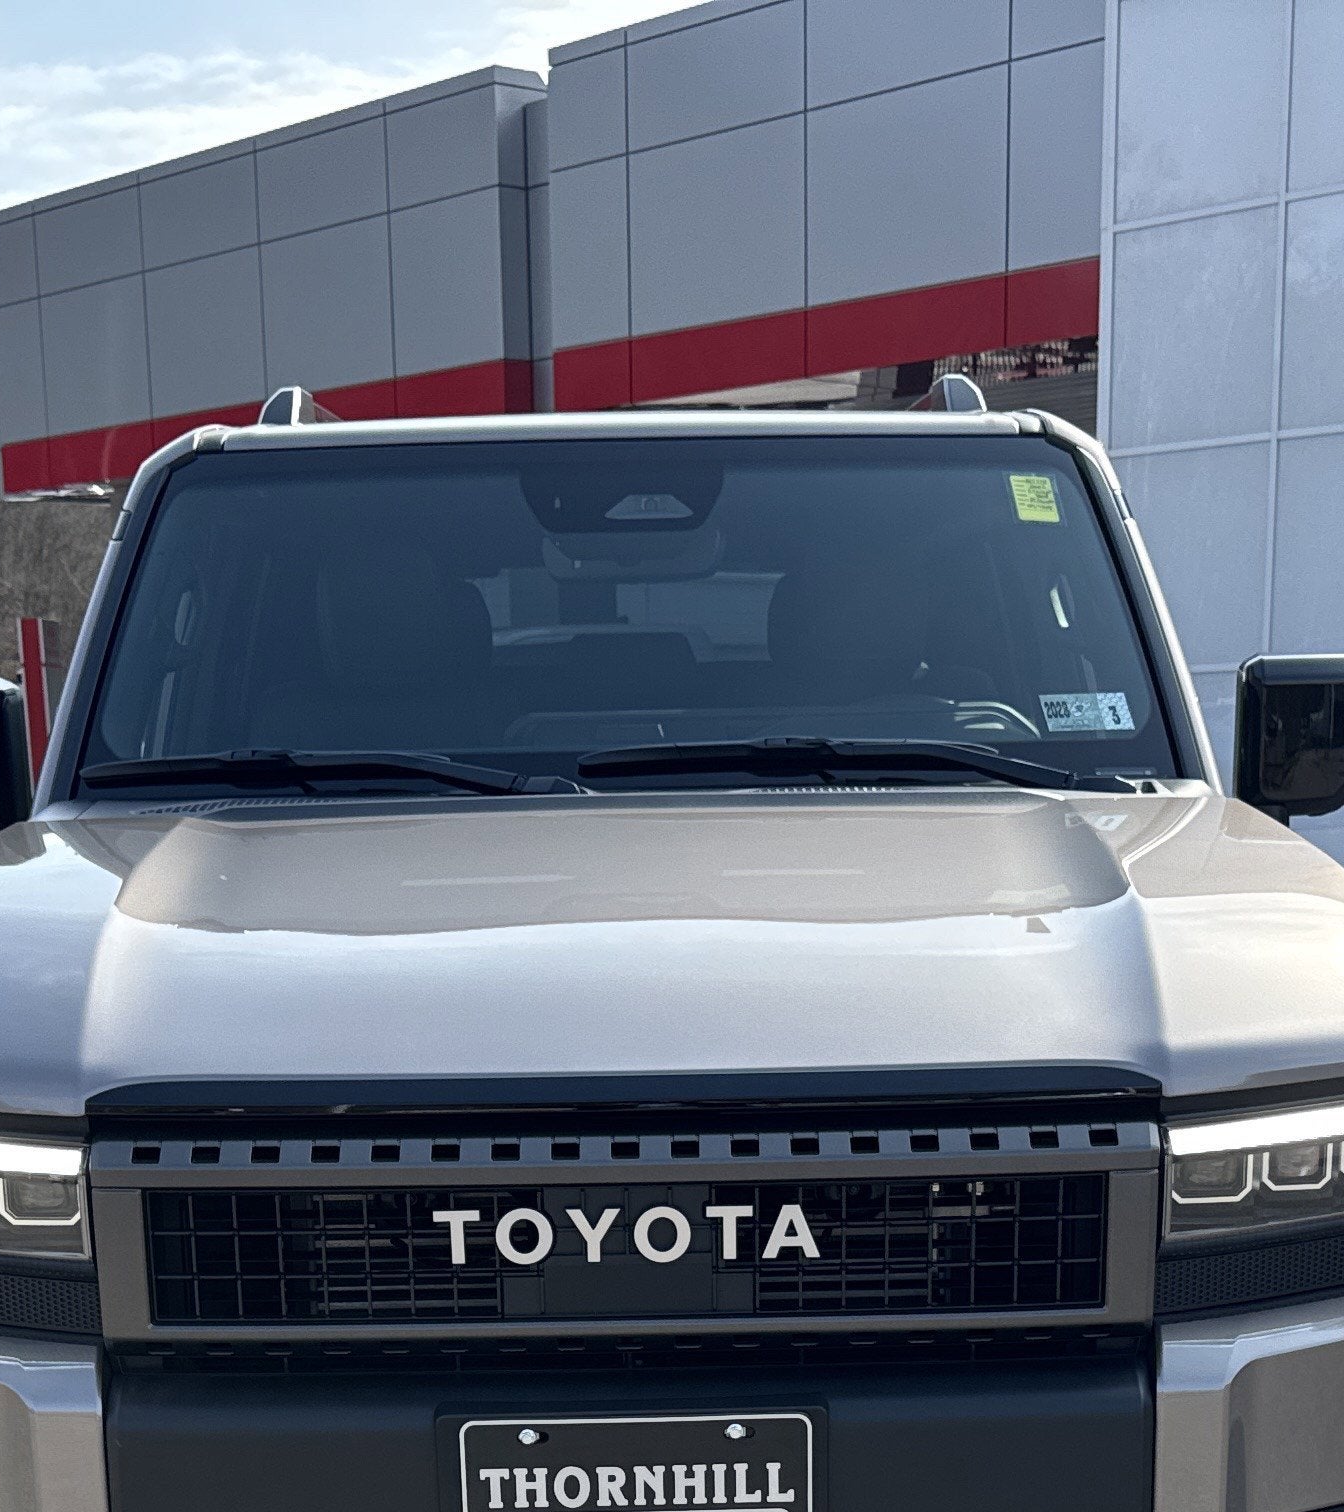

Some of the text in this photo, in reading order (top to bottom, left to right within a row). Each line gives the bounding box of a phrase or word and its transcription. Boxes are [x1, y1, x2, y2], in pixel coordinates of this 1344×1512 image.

[1108, 705, 1121, 725] 3
[432, 1204, 821, 1265] TOYOTA
[479, 1462, 795, 1510] THORNHILL
